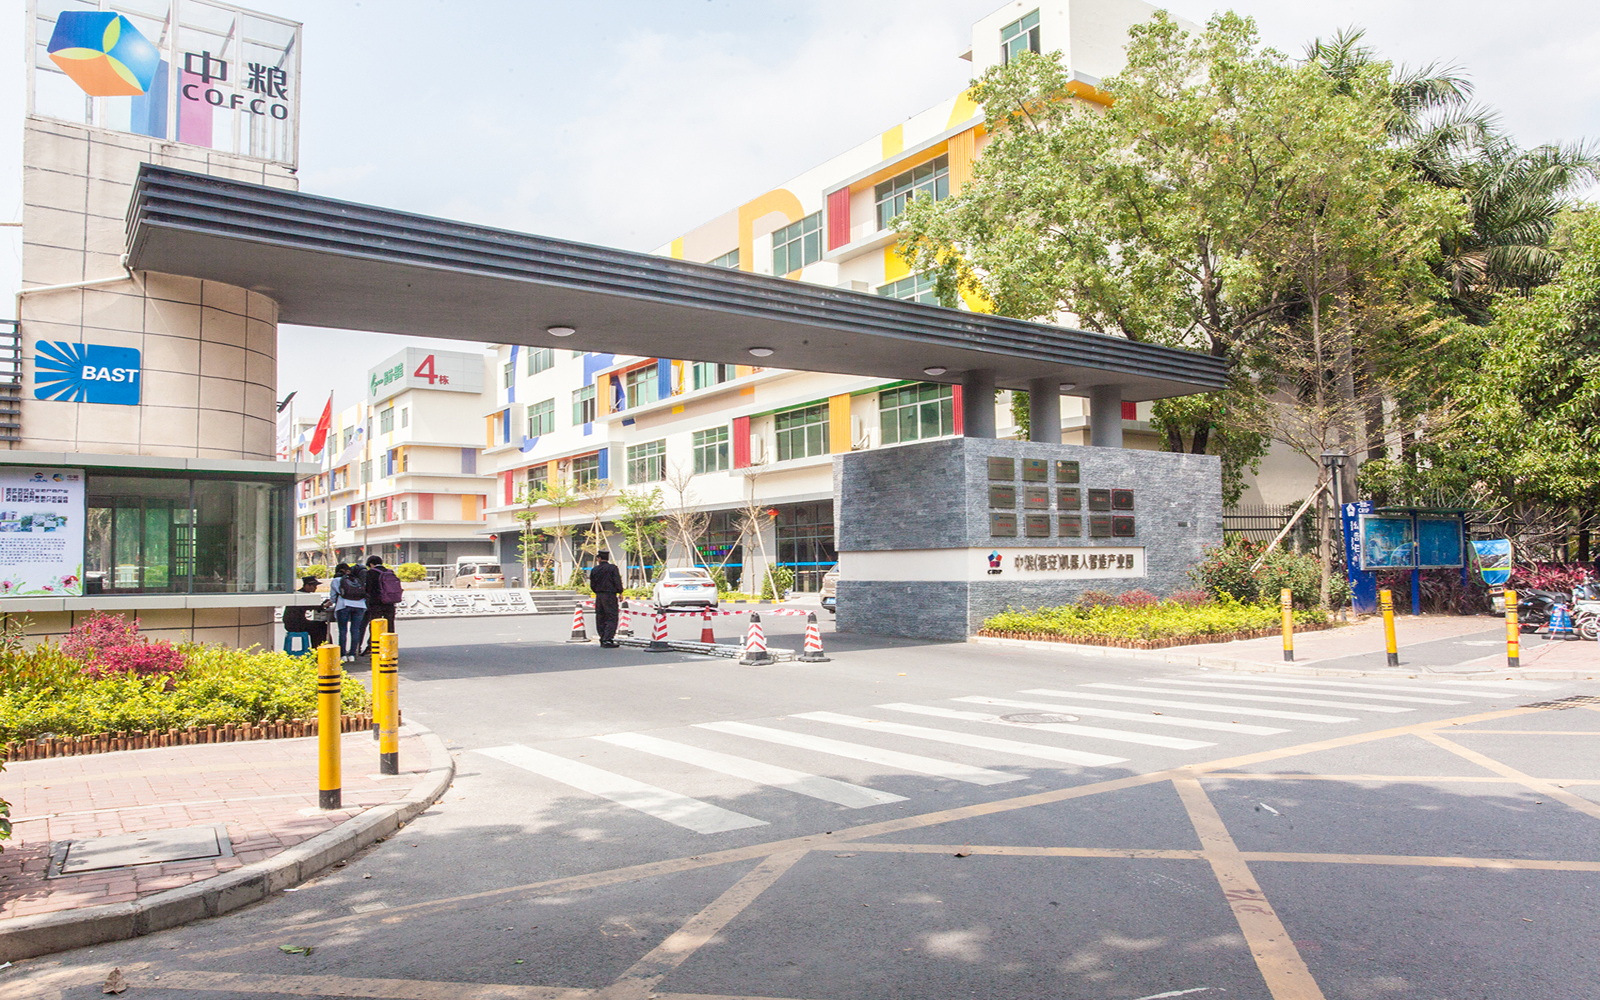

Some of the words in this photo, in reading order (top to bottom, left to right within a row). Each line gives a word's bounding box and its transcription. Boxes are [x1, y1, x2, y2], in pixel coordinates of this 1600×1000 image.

[184, 50, 289, 102] 中粮
[182, 83, 289, 120] COFCO
[81, 365, 138, 383] BAST
[428, 607, 496, 615] INDUSTRIAL
[498, 605, 529, 613] PARK
